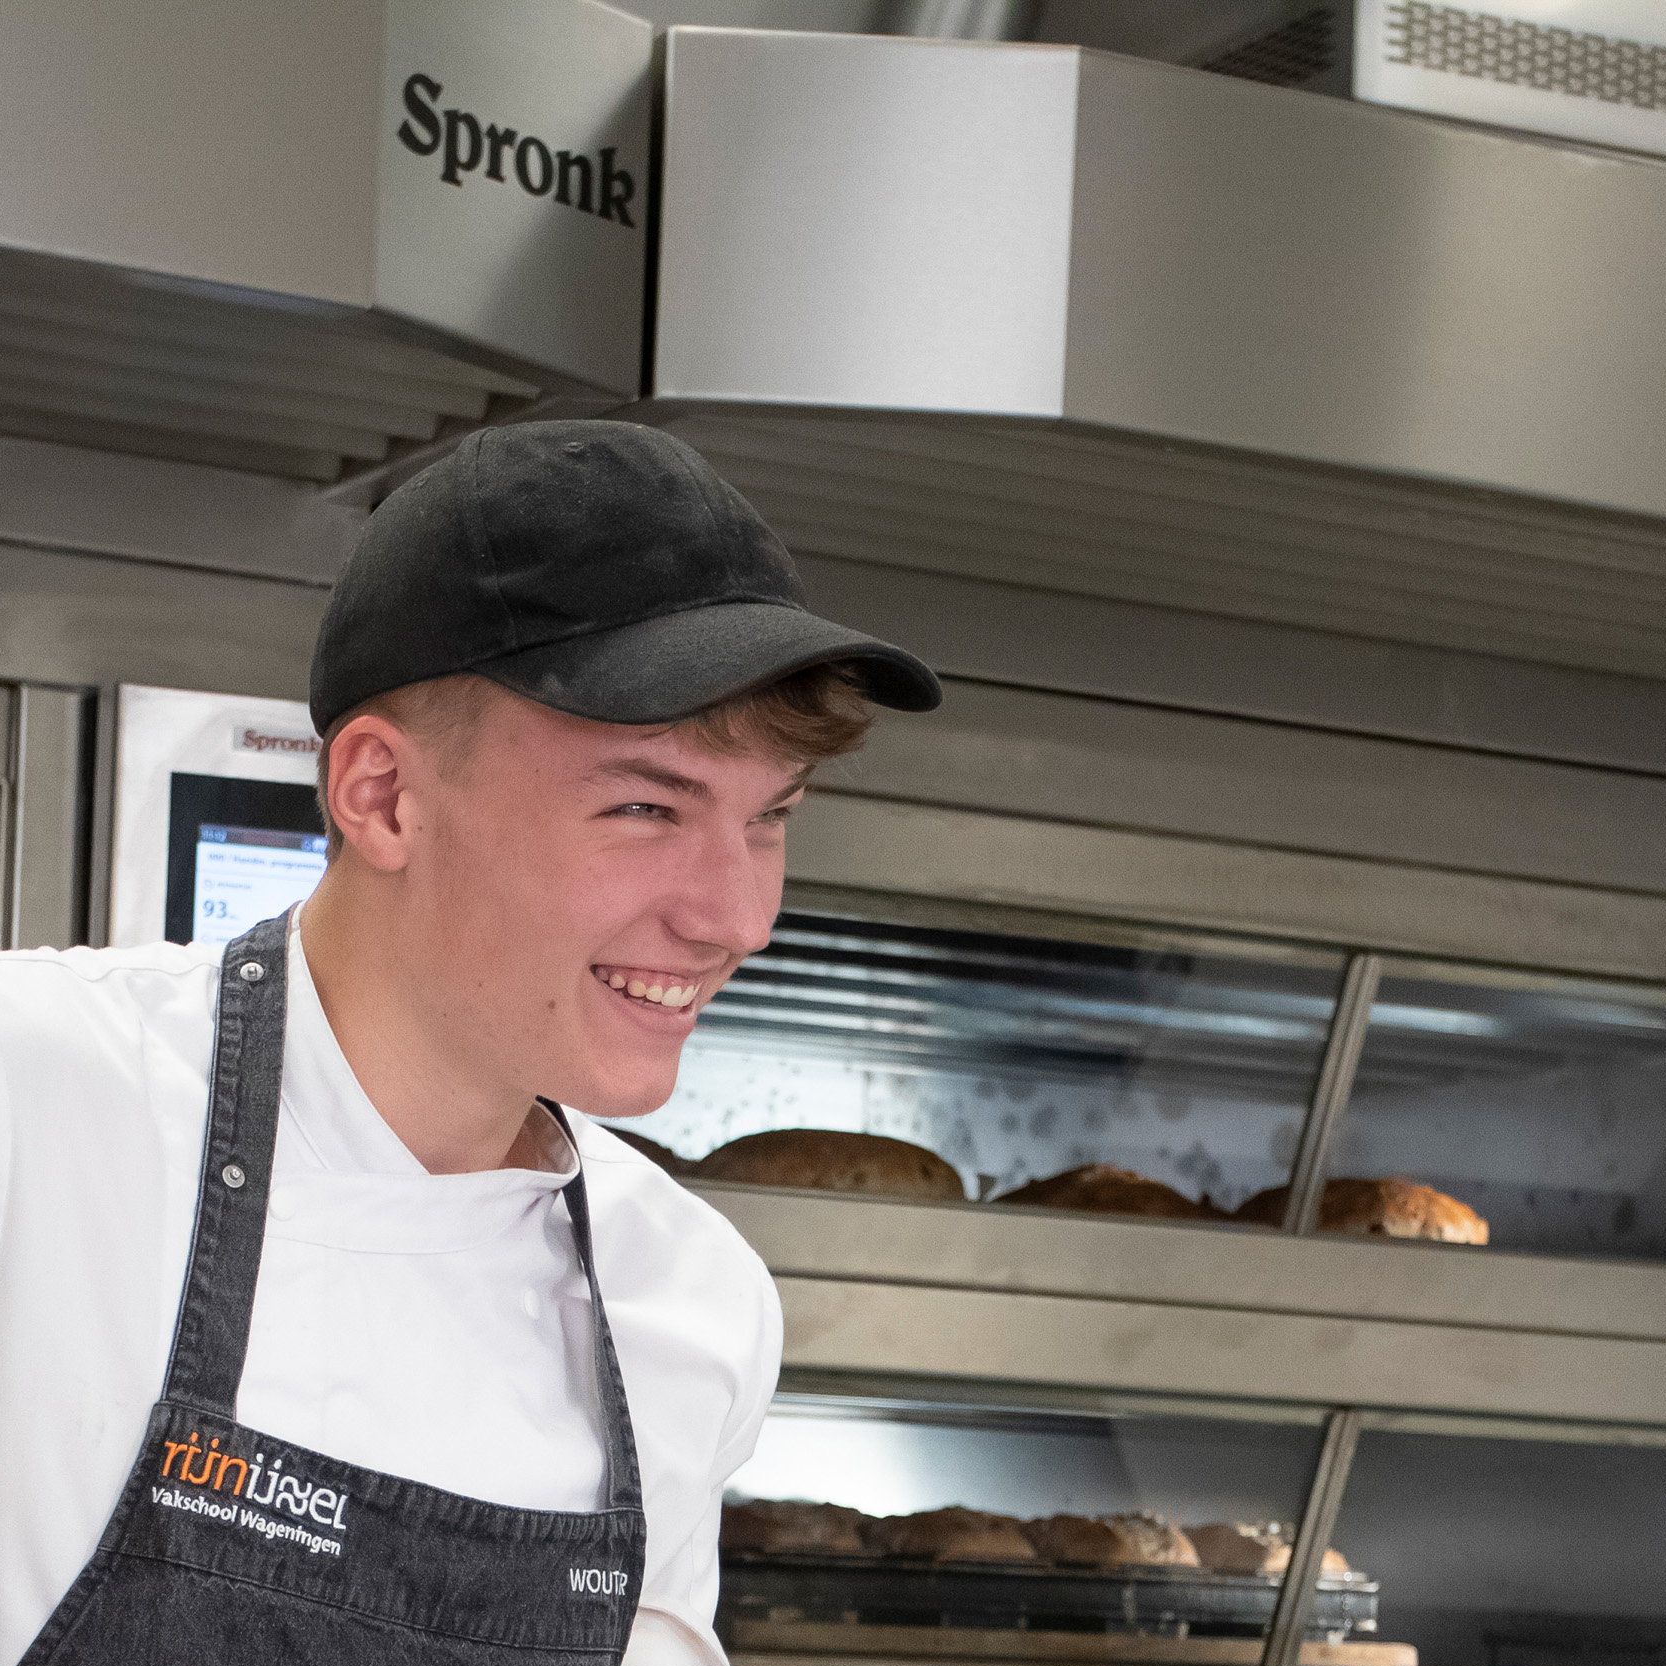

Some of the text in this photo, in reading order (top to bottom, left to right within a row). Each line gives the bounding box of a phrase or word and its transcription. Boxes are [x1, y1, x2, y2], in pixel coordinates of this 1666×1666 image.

[396, 72, 636, 229] Spronk
[202, 900, 227, 918] 93
[151, 1486, 341, 1556] Vakschool Wageningen
